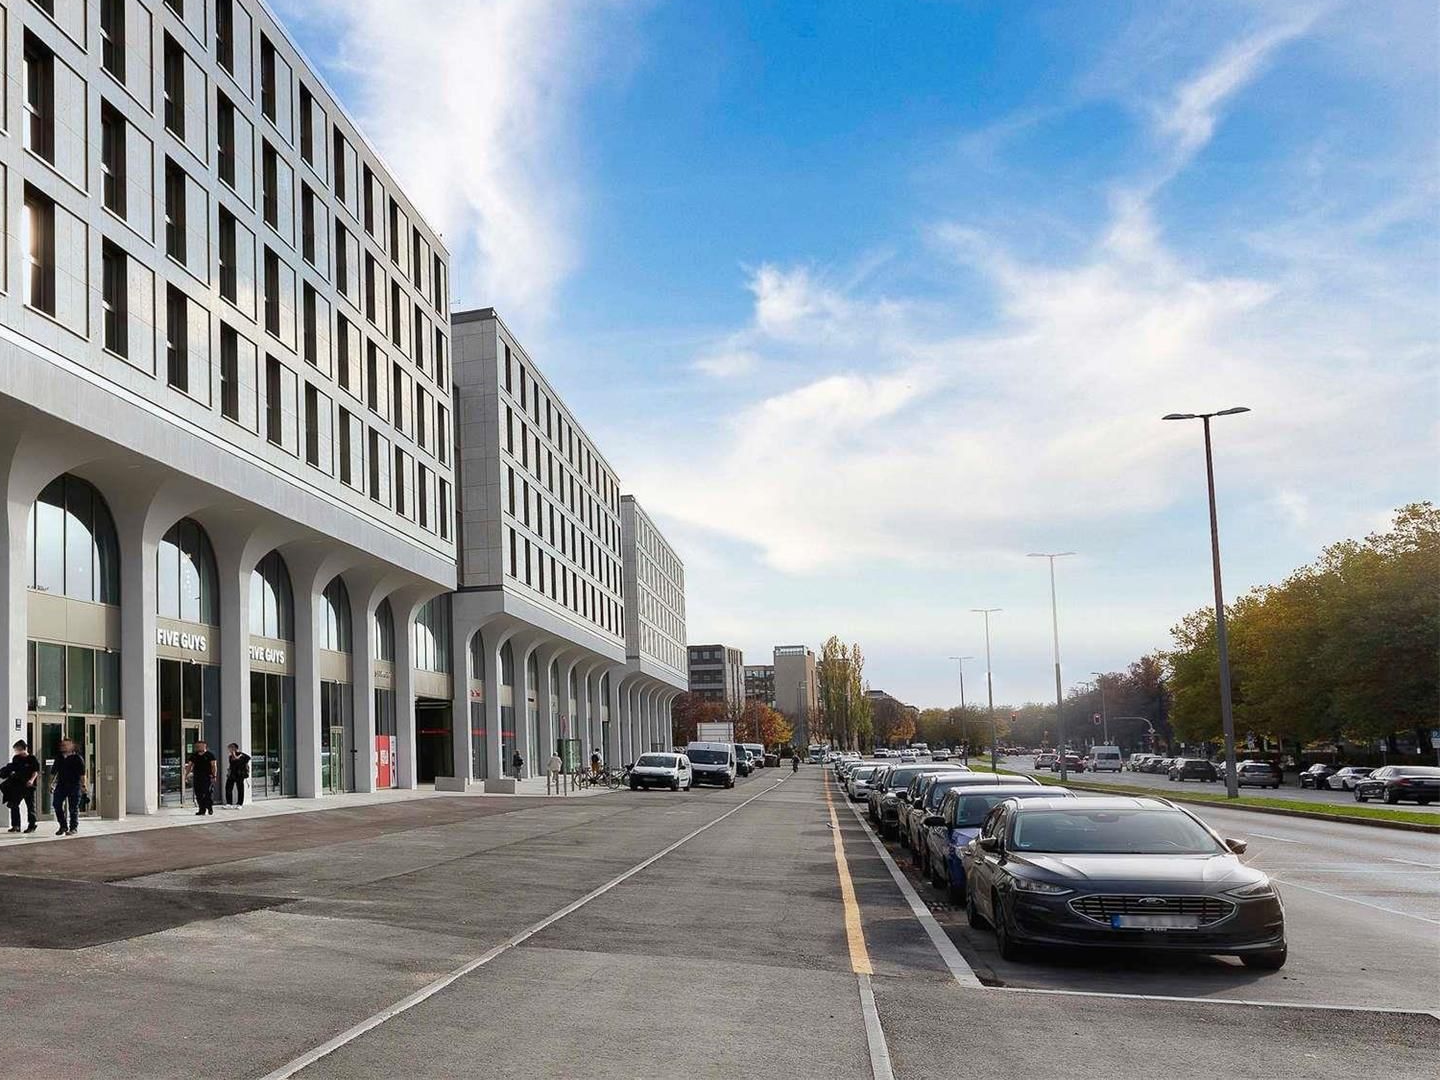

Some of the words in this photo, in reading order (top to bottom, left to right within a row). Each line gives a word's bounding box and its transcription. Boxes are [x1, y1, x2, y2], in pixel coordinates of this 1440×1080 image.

[157, 628, 180, 648] FIVE
[181, 633, 207, 653] GUYS
[249, 645, 265, 662] FIVE
[265, 648, 285, 664] GUYS
